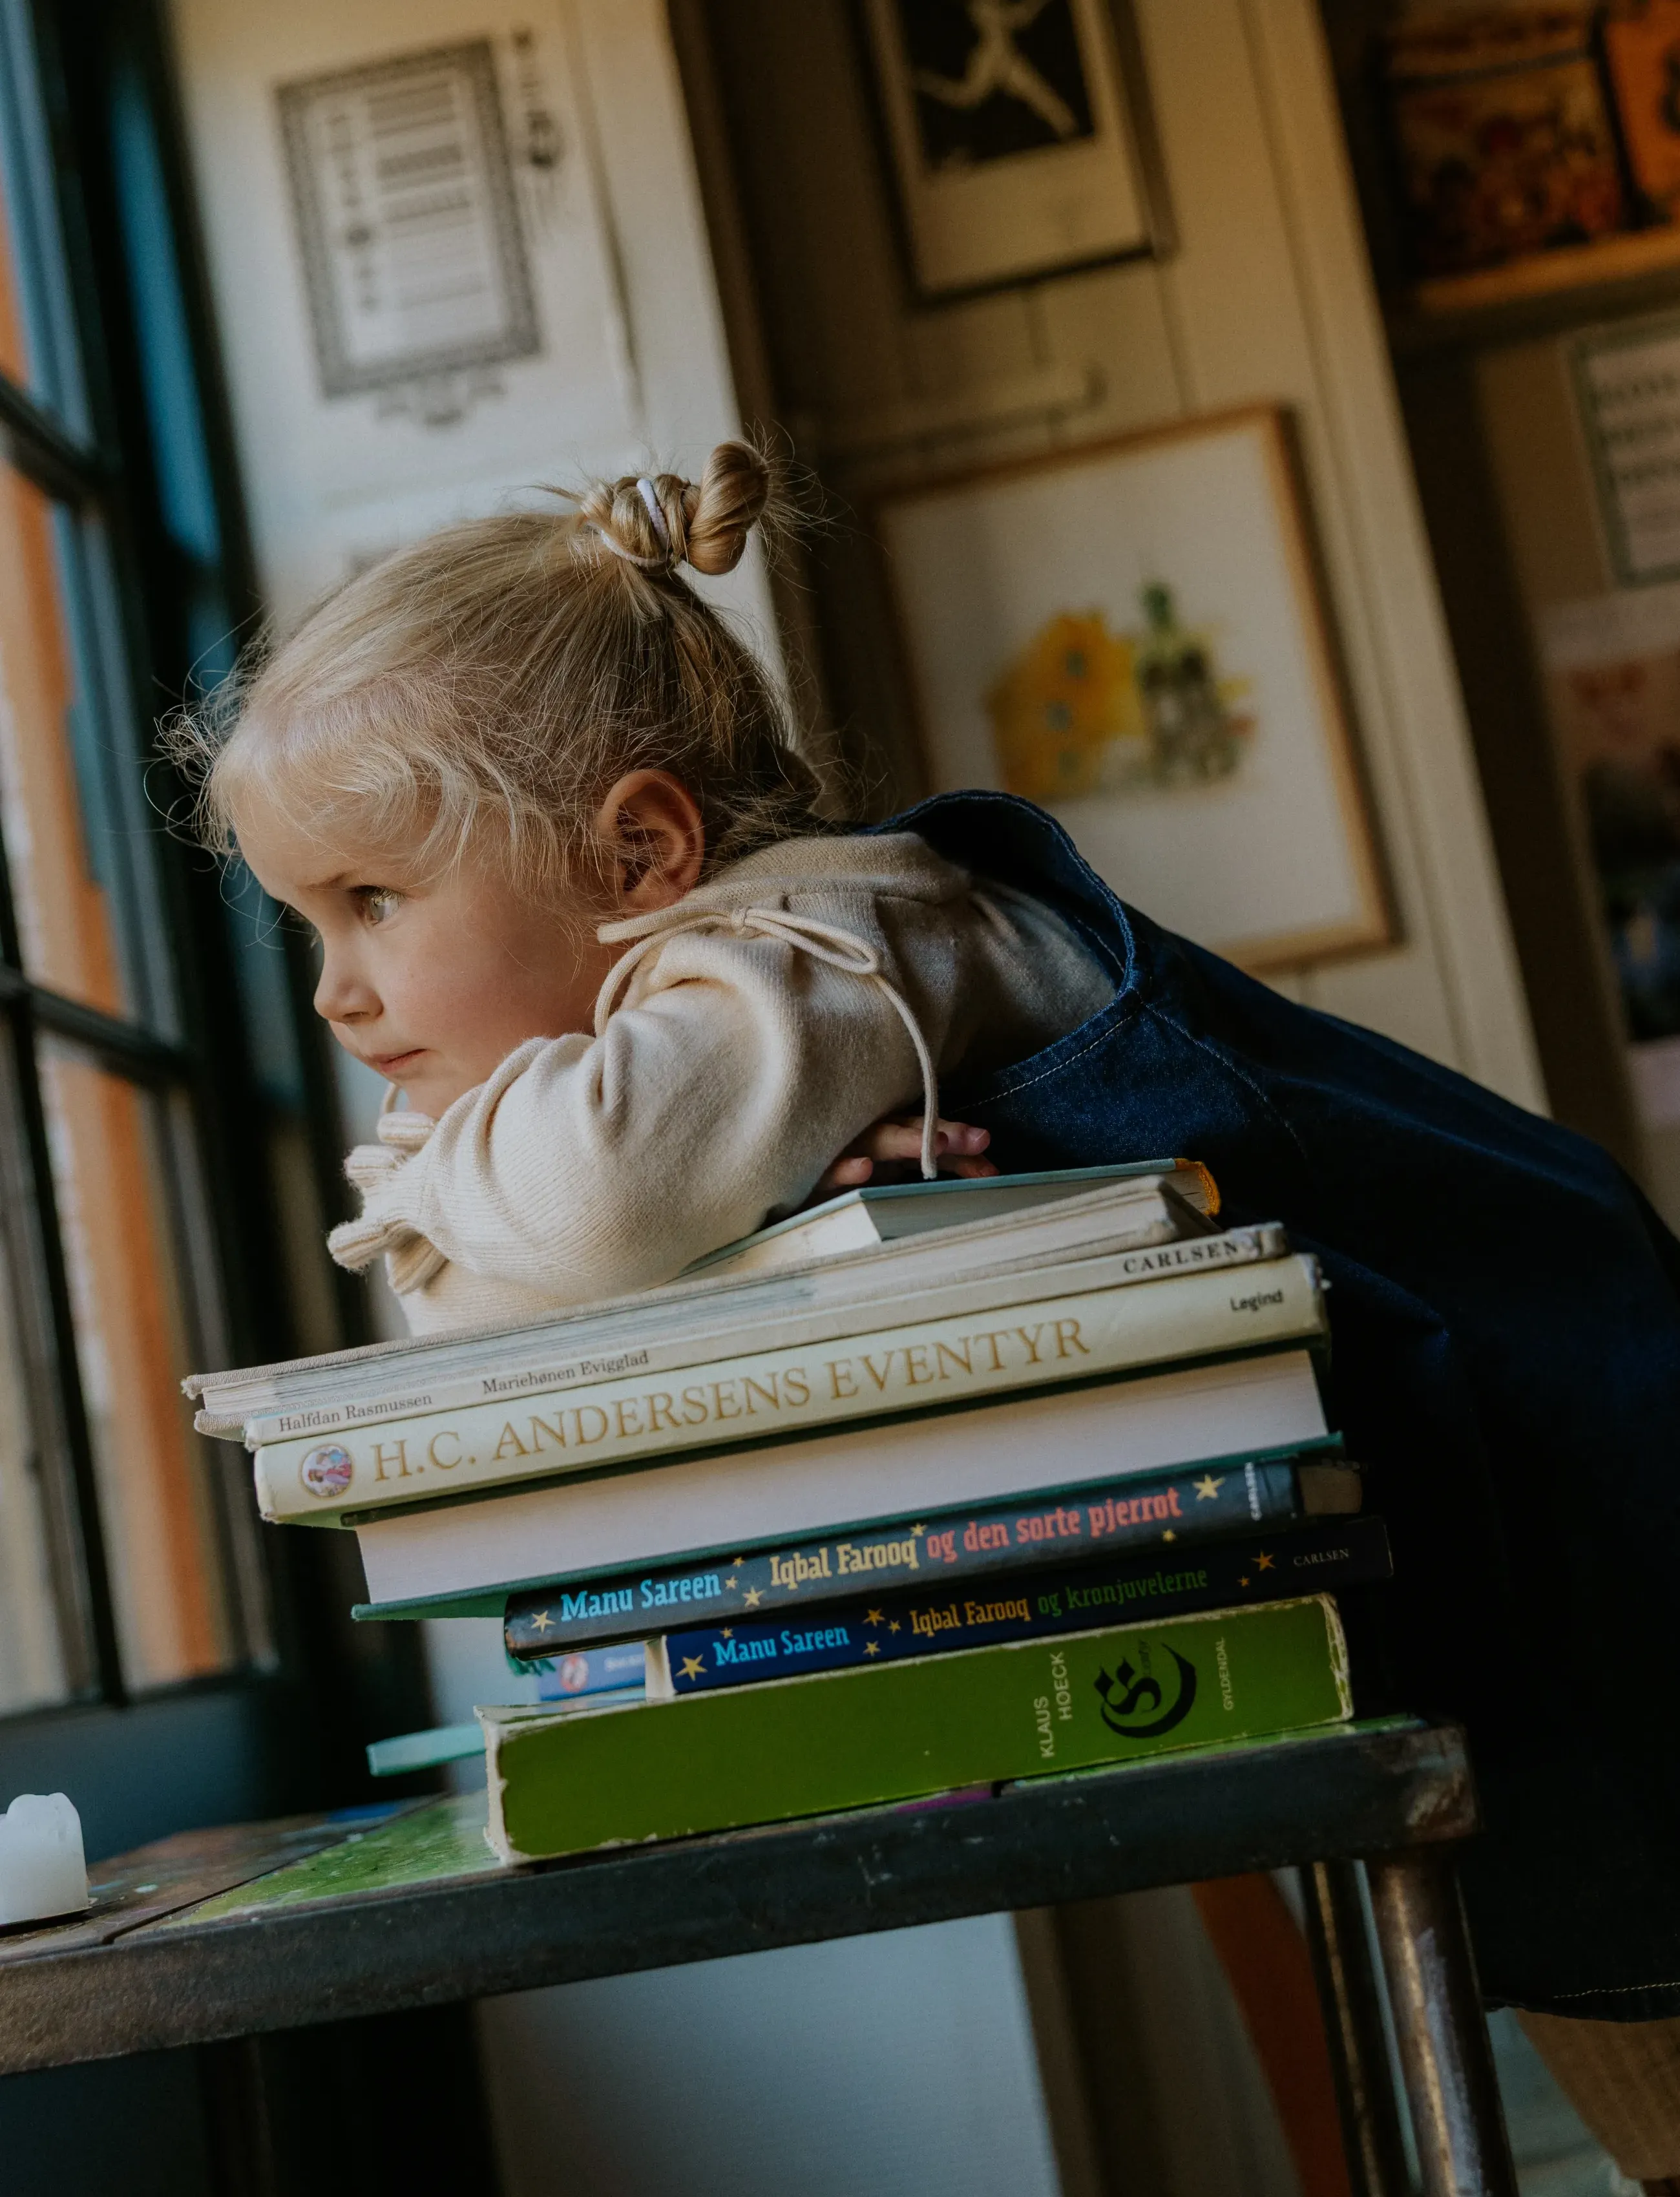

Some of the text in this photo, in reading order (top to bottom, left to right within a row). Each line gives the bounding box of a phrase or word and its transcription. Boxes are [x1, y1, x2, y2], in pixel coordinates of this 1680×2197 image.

[278, 1239, 1239, 1433] Halfdan Rasmussen Mariehønen Evigglad CARLSEN
[373, 1316, 1091, 1482] H.C. ANDERSENS EVENTYR
[560, 1486, 1184, 1623] Manu Sareen Iqbal Farooq og den sorte pjerrot
[1292, 1548, 1350, 1567] CARLSEN
[713, 1568, 1208, 1668] Manu Sareen Iqbal Farooq og kronjuvelerne
[1049, 1650, 1074, 1721] HOECK
[1215, 1636, 1235, 1712] GYLDENDAL
[1033, 1694, 1056, 1759] KLAUS
